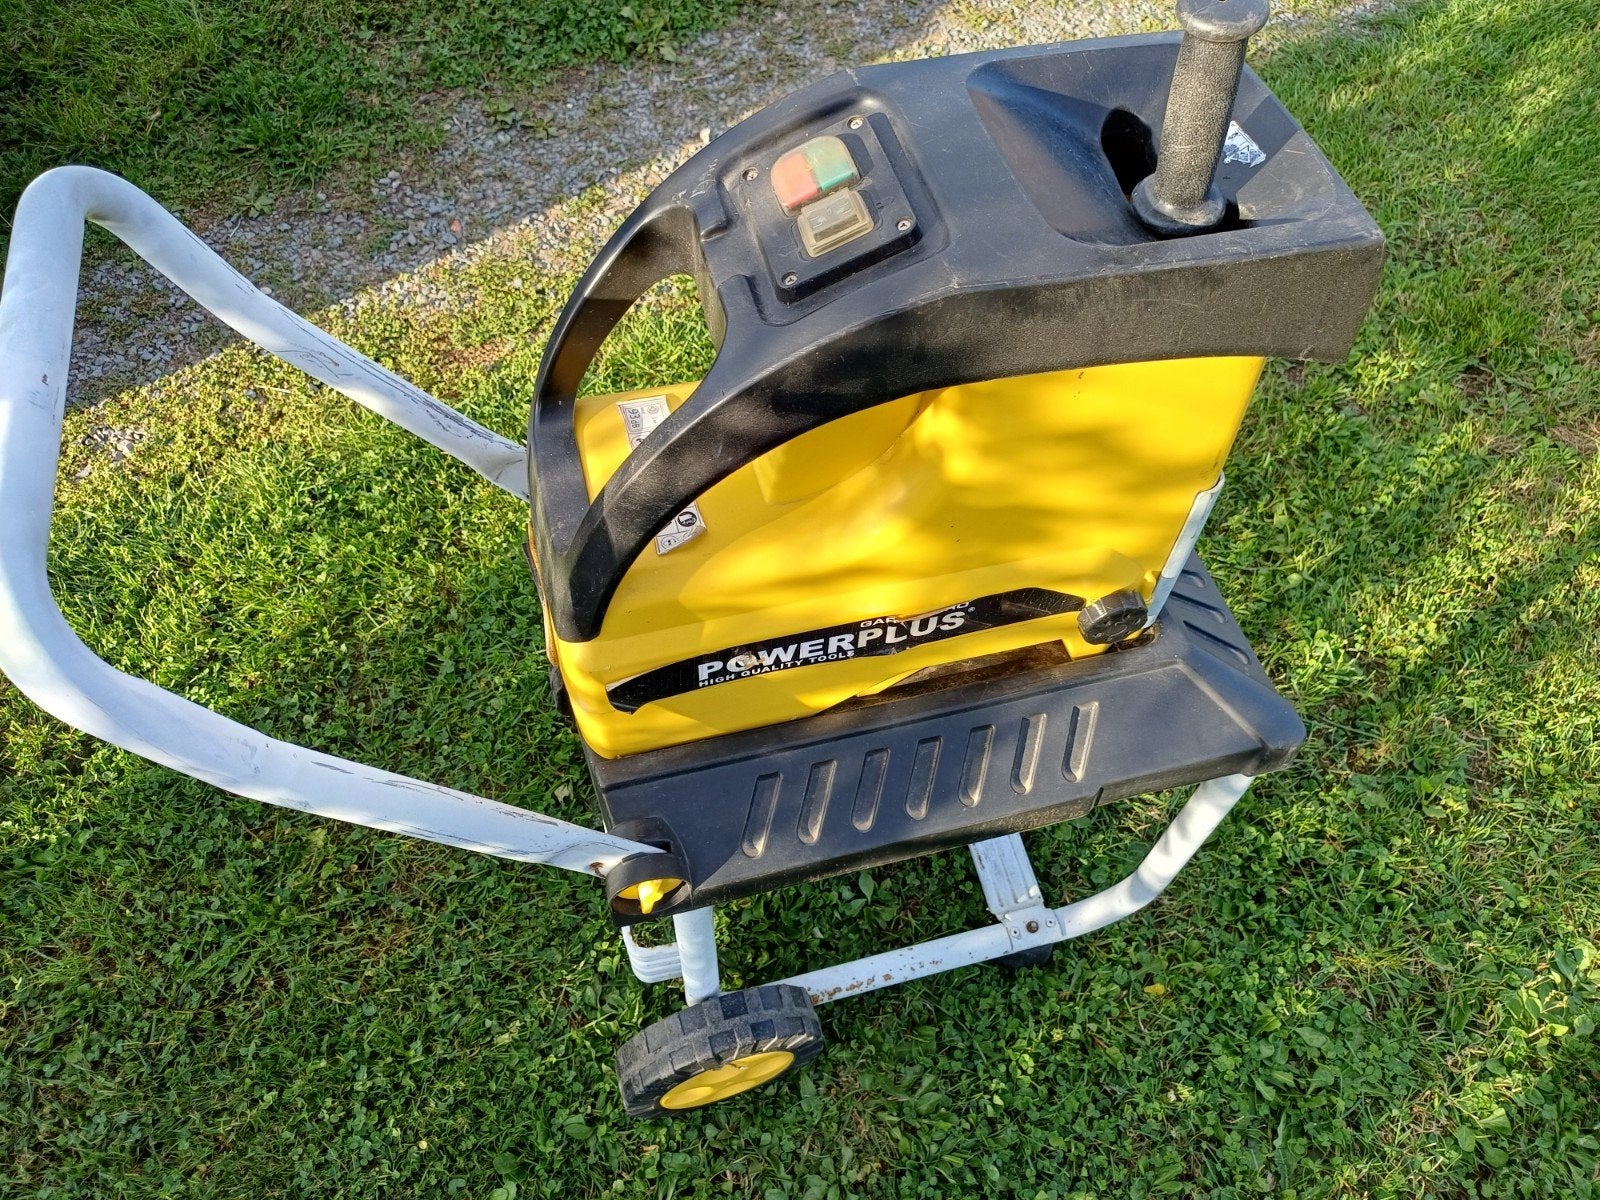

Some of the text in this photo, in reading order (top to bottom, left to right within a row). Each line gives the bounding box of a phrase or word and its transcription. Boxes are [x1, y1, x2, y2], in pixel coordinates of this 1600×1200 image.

[698, 650, 855, 688] HIGH QUALITY TOOLS
